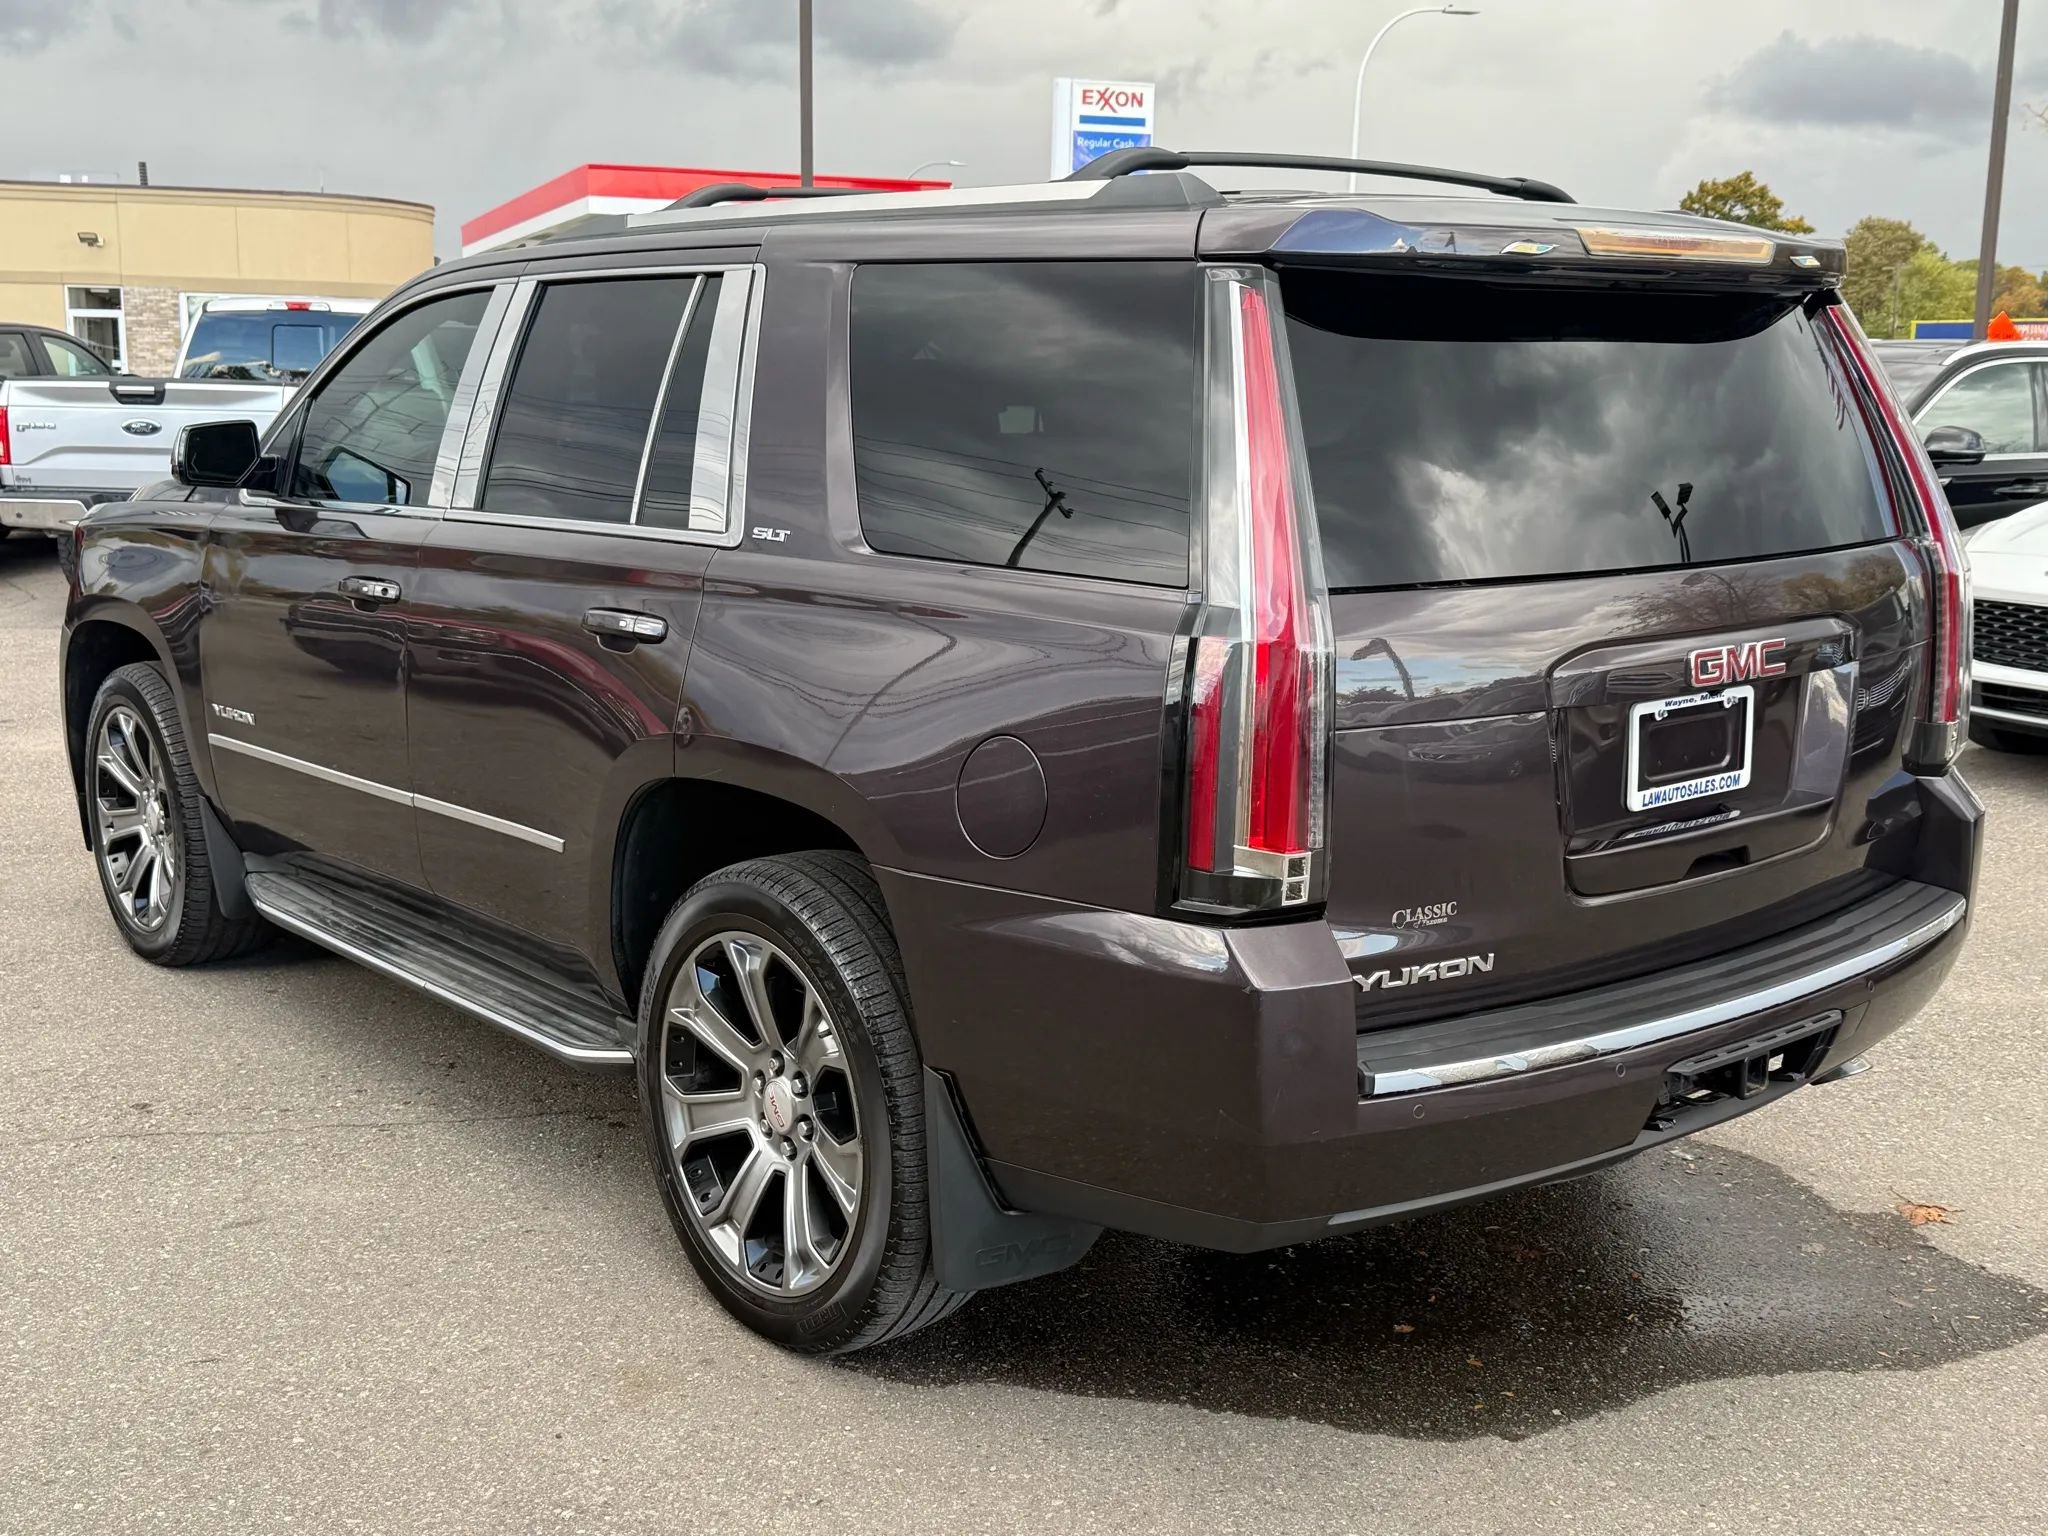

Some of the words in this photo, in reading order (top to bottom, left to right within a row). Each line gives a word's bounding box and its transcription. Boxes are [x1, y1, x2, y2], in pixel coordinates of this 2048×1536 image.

[1081, 87, 1144, 114] EXXON
[1077, 137, 1111, 149] Regular
[1113, 138, 1135, 149] Cash
[752, 526, 791, 542] SLT
[1690, 637, 1787, 688] GMC
[211, 703, 256, 726] YUKON
[1664, 697, 1697, 708] Wayne,
[1642, 773, 1741, 808] LAWAUTOSALES.COM
[1392, 901, 1458, 930] CLASSIC
[1352, 953, 1495, 993] YUKON
